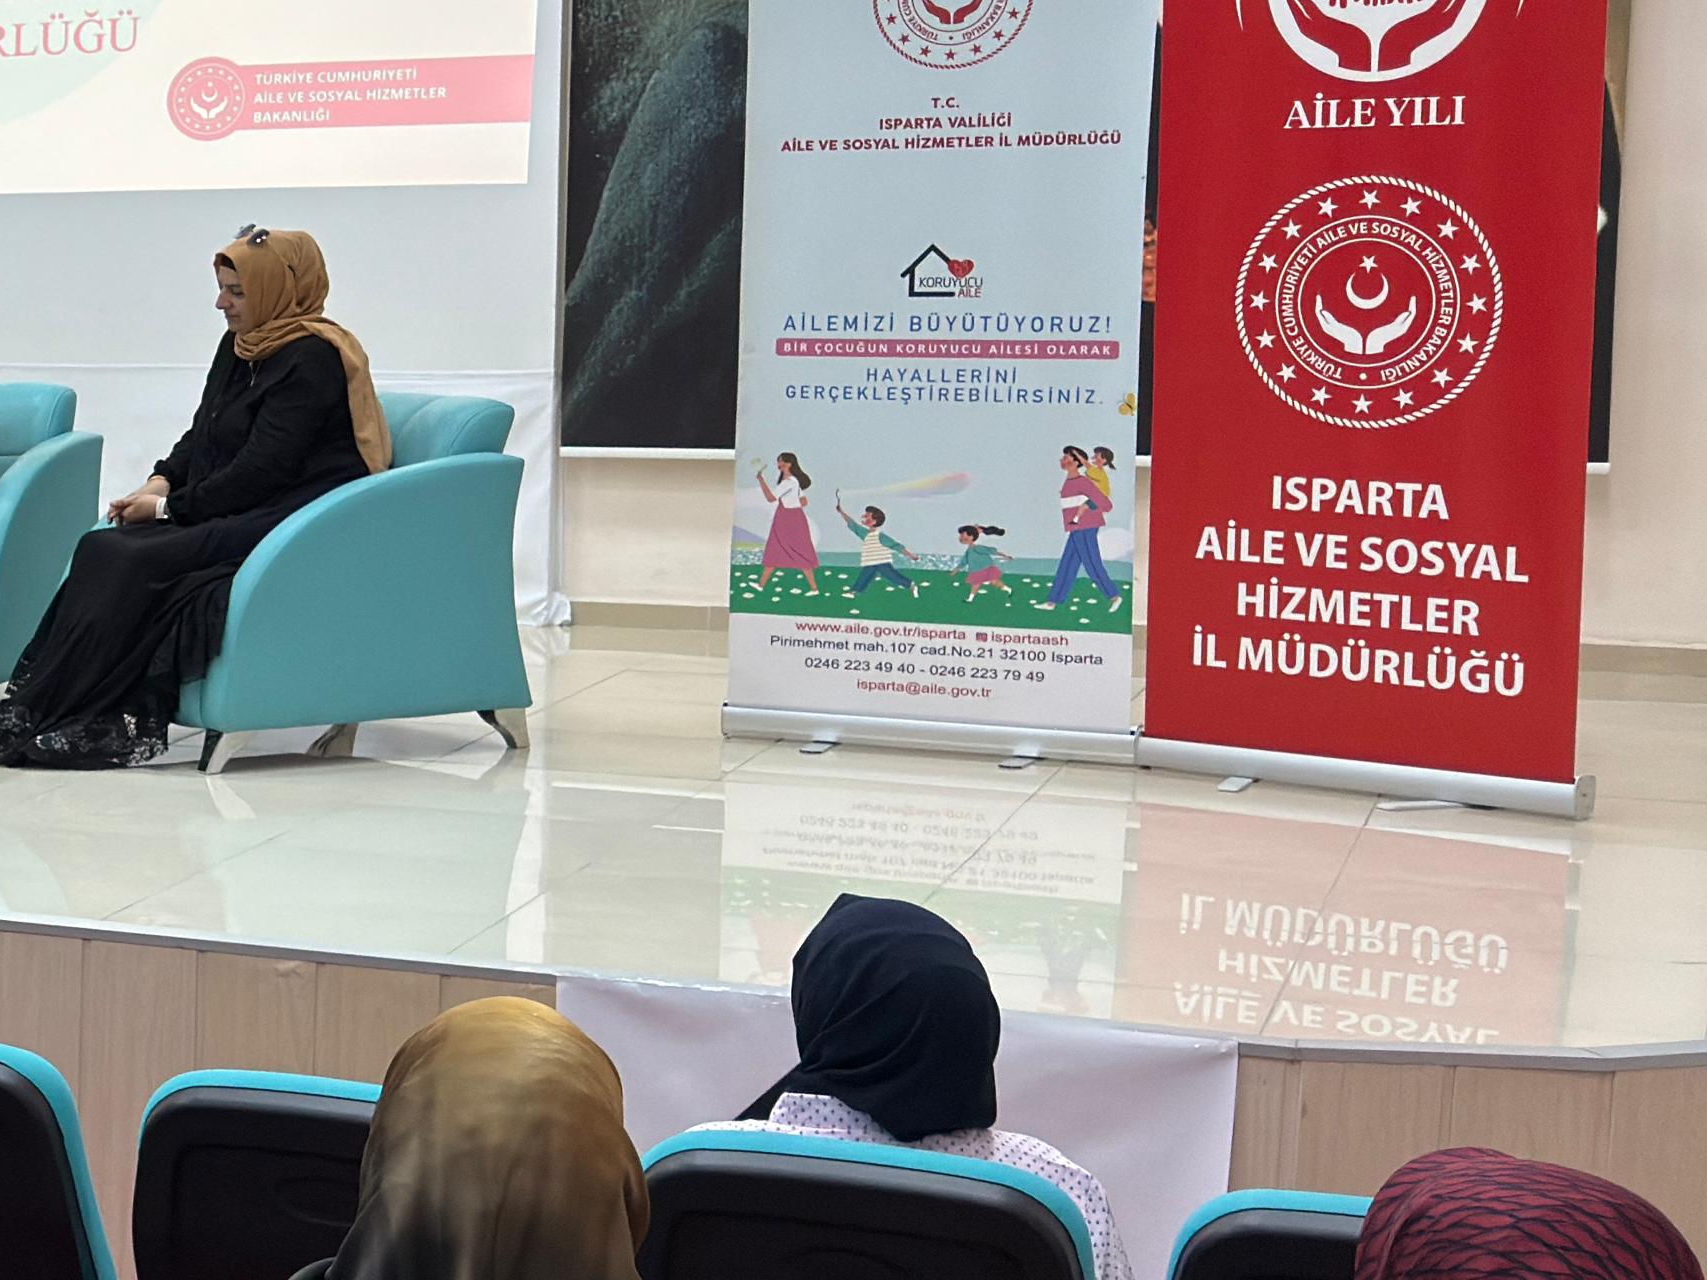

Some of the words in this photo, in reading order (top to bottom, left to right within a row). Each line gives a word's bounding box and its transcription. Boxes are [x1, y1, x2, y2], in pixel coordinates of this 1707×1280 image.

[254, 91, 283, 104] AİLE
[288, 91, 304, 103] VE
[309, 88, 361, 102] SOSYAL
[931, 97, 960, 109] T.C.
[254, 109, 329, 123] BAKANLIĞI
[879, 116, 942, 130] ISPARTA
[948, 112, 1011, 128] VALİLİĞİ
[1284, 92, 1377, 129] AİLE
[1384, 96, 1466, 127] YILI
[781, 137, 814, 152] AİLE
[819, 139, 837, 151] VE
[842, 136, 900, 150] SOSYAL
[905, 134, 994, 149] HİZMETLER
[999, 132, 1012, 147] İL
[1018, 129, 1121, 146] MÜDÜRLÜĞÜ
[1315, 224, 1347, 249] AİLE
[1349, 222, 1368, 235] VE
[1371, 221, 1421, 252] SOSYAL
[918, 276, 983, 289] KORUYUCU
[957, 287, 982, 298] AİLE
[1281, 242, 1318, 334] CUMHURİYETİ
[1422, 246, 1454, 326] HİZMETLER
[784, 312, 894, 332] AİLEMİZİ
[909, 312, 1111, 334] BÜYÜTÜYORUZ!
[783, 340, 808, 354] BİR
[814, 340, 887, 356] ÇOCUĞUN
[896, 342, 982, 354] KORUYUCU
[989, 340, 1038, 355] AİLESİ
[1046, 342, 1111, 356] OLARAK
[1296, 334, 1342, 381] TÜRKİYE
[1380, 326, 1447, 382] BAKANLIĞI
[866, 366, 1017, 384] HAYALLERİNİ
[1272, 475, 1450, 520] ISPARTA
[1195, 519, 1285, 565] AİLE
[1295, 532, 1348, 569] VE
[1359, 536, 1529, 583] SOSYAL
[1237, 576, 1479, 636] HİZMETLER
[770, 635, 850, 651] Pirimehmet
[853, 641, 915, 655] mah.107
[921, 645, 993, 659] cad.No.21
[999, 648, 1046, 662] 32100
[1051, 652, 1103, 666] Isparta
[991, 631, 1069, 647] ispartaash
[804, 657, 840, 670] 0246
[844, 659, 870, 671] 223
[875, 660, 893, 673] 49
[897, 662, 915, 675] 40
[929, 664, 966, 678] 0246
[970, 666, 998, 679] 223
[1003, 669, 1021, 681] 79
[1026, 670, 1044, 682] 49
[1193, 624, 1227, 668] İL
[1237, 632, 1524, 697] MÜDÜRLÜĞÜ
[857, 679, 992, 699] isparta@aile.gov.tr
